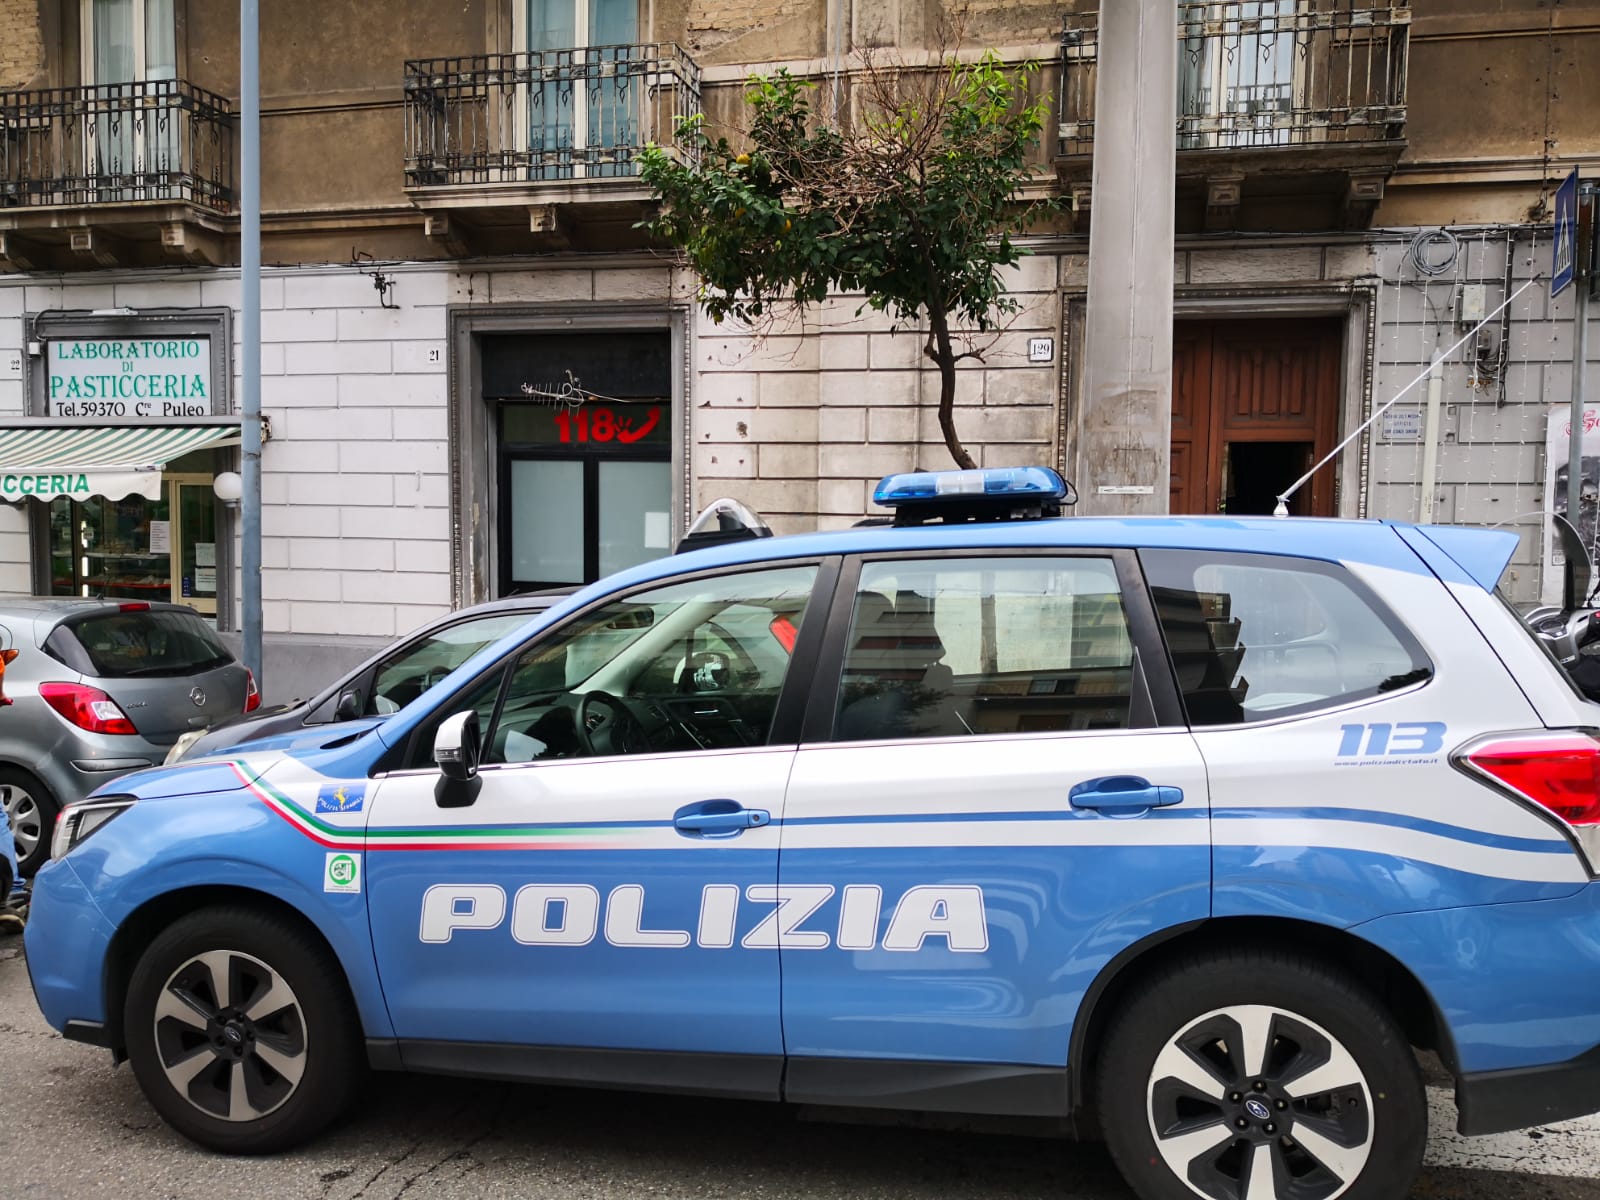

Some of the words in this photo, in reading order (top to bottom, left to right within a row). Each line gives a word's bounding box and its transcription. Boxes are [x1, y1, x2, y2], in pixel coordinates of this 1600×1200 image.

[58, 341, 200, 360] LABORATORIO
[429, 349, 439, 361] 21
[1033, 343, 1050, 355] 129
[10, 359, 20, 370] 22
[122, 361, 134, 373] DI
[50, 374, 207, 399] PASTICCERIA
[56, 401, 126, 417] Tel.59370
[162, 401, 205, 417] Puleo
[553, 407, 616, 444] 118
[0, 473, 90, 494] CCERIA
[1337, 721, 1448, 757] 113
[418, 883, 989, 953] POLIZIA
